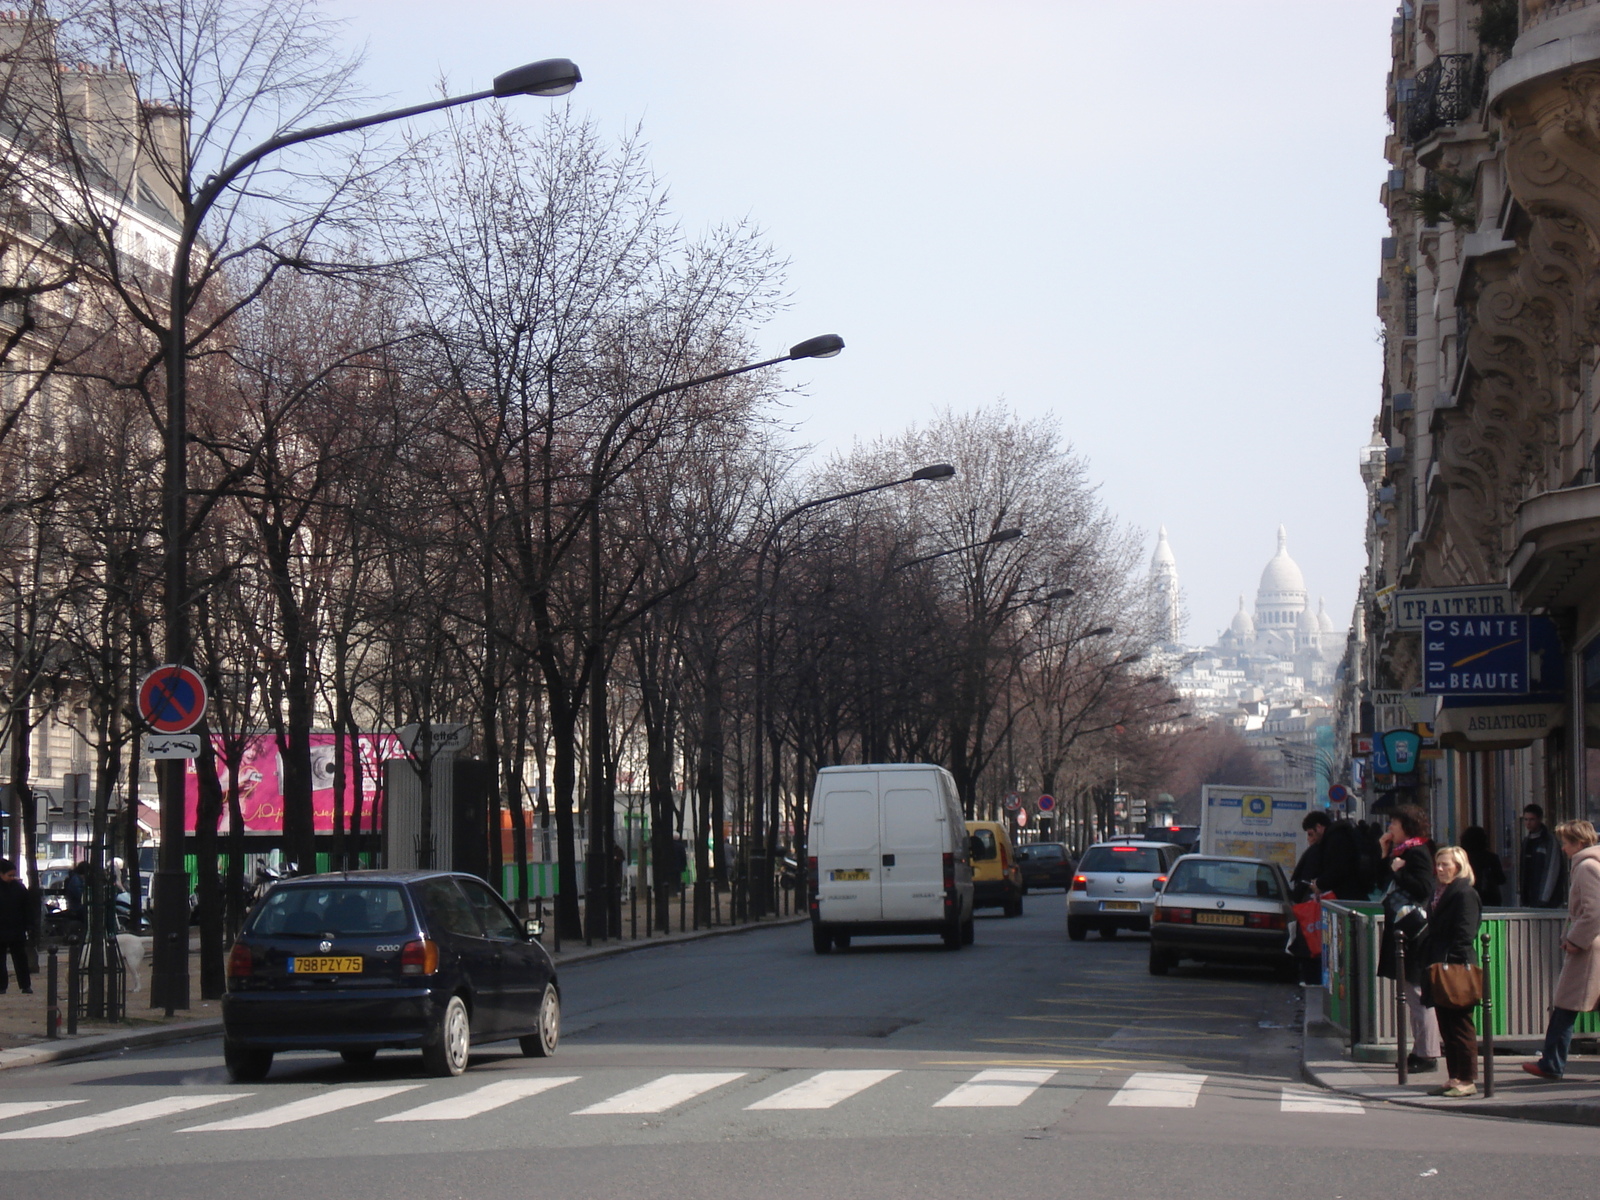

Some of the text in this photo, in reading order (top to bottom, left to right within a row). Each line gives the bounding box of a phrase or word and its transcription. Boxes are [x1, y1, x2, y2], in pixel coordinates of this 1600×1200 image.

[1403, 595, 1506, 620] TRAITEUR
[1450, 621, 1518, 636] SANTE
[1428, 620, 1446, 689] EURO
[1450, 673, 1519, 689] BEAUTE
[1468, 713, 1548, 731] ASIATIQUE
[296, 958, 361, 972] 798 PZY 75
